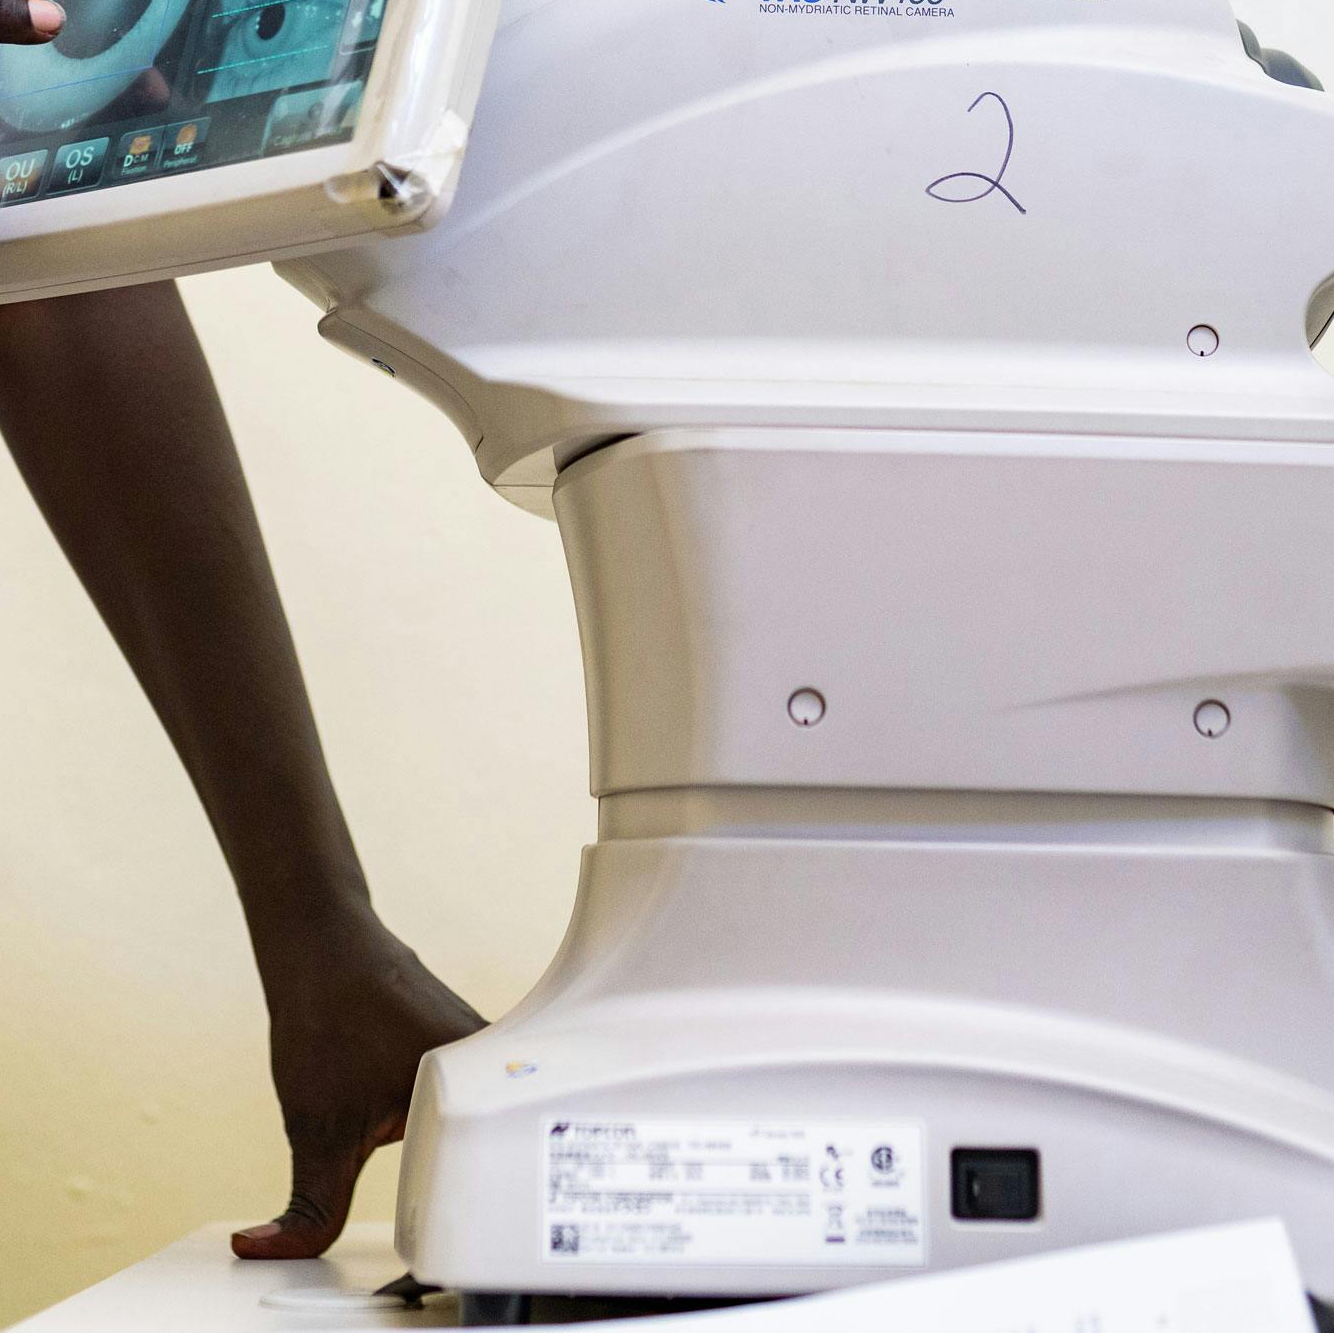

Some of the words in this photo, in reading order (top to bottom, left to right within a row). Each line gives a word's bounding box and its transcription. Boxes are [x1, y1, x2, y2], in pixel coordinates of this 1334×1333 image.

[759, 4, 851, 15] NON-MYDRIATIC
[854, 5, 902, 16] RETINAL
[905, 7, 955, 17] CAMERA
[174, 142, 194, 155] OFF
[66, 146, 95, 168] OS
[5, 159, 36, 181] OU
[67, 169, 83, 185] (L)
